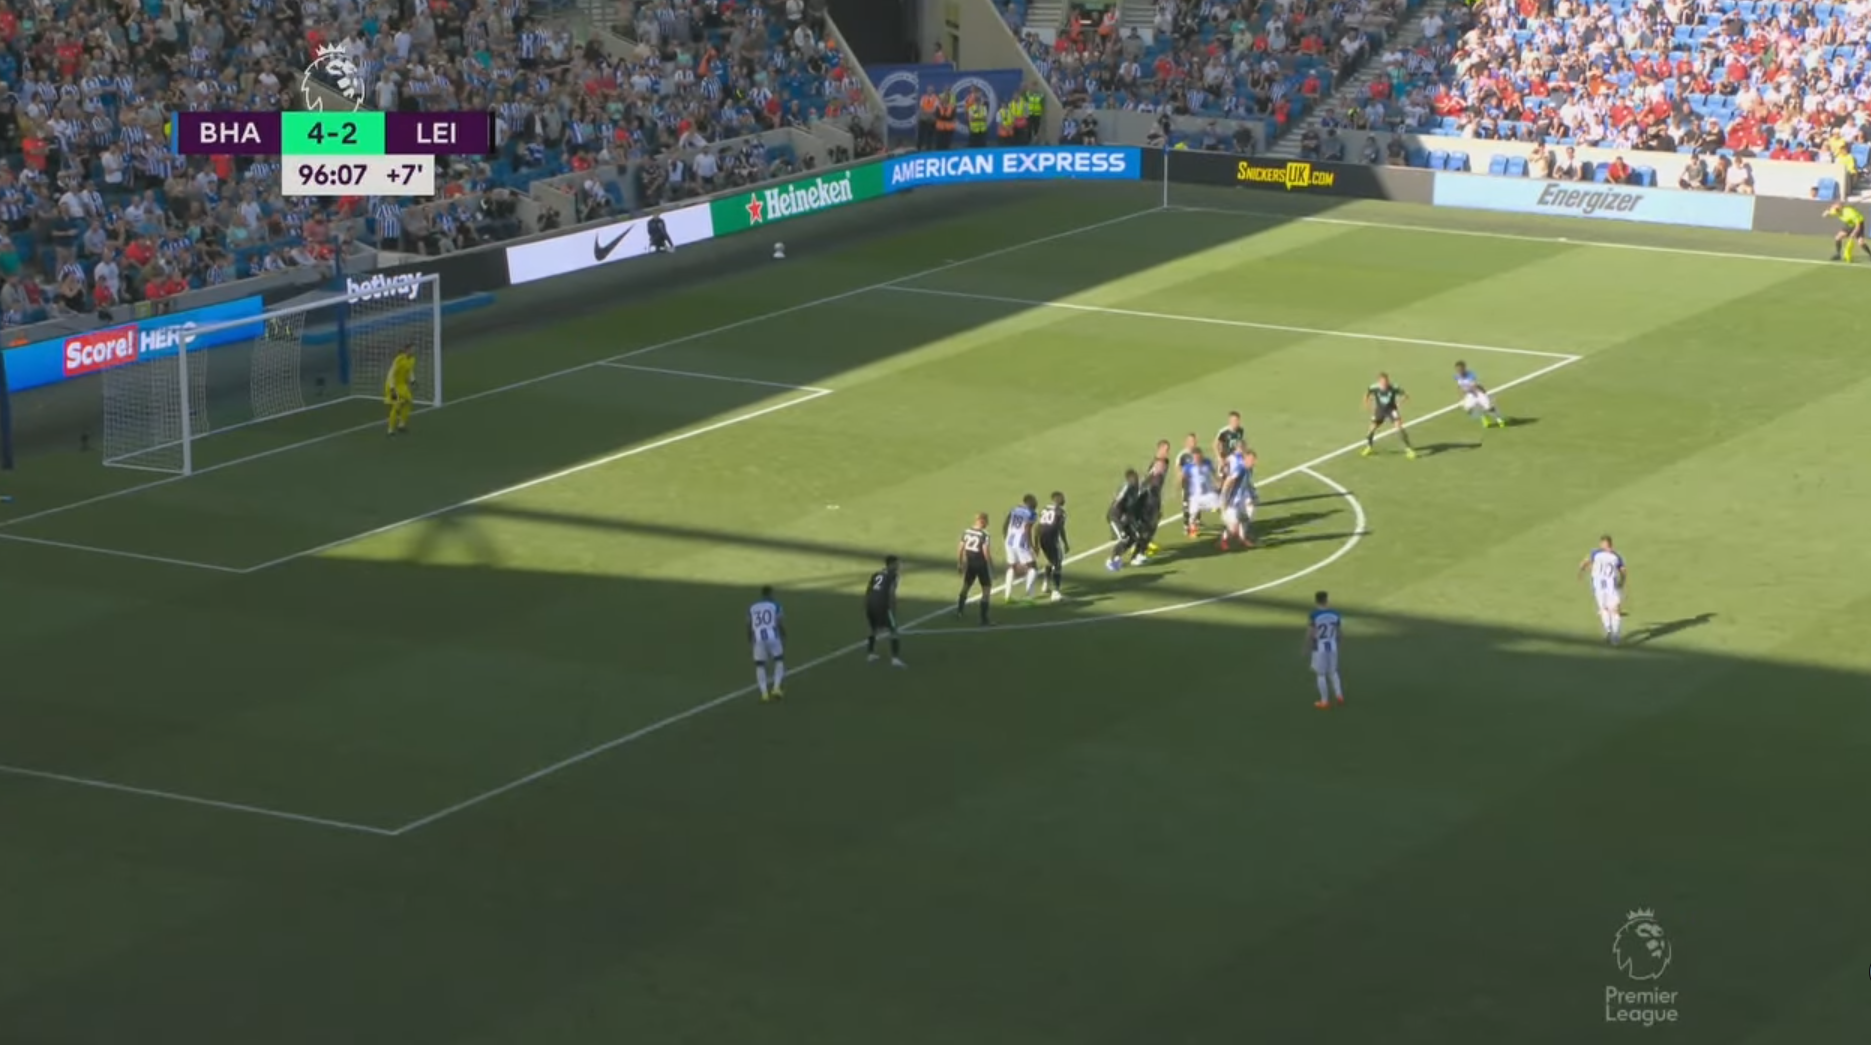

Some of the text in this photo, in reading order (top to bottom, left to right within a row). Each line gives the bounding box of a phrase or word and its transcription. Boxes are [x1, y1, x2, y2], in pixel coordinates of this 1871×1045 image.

[892, 152, 1126, 185] AMERICAN EXPRESS
[764, 172, 853, 219] Heineken
[1536, 183, 1644, 214] Energizer
[346, 271, 422, 303] betway
[66, 330, 134, 369] Score!
[964, 534, 979, 552] 22
[872, 574, 883, 590] 2
[754, 609, 772, 627] 30
[1318, 622, 1337, 640] 27
